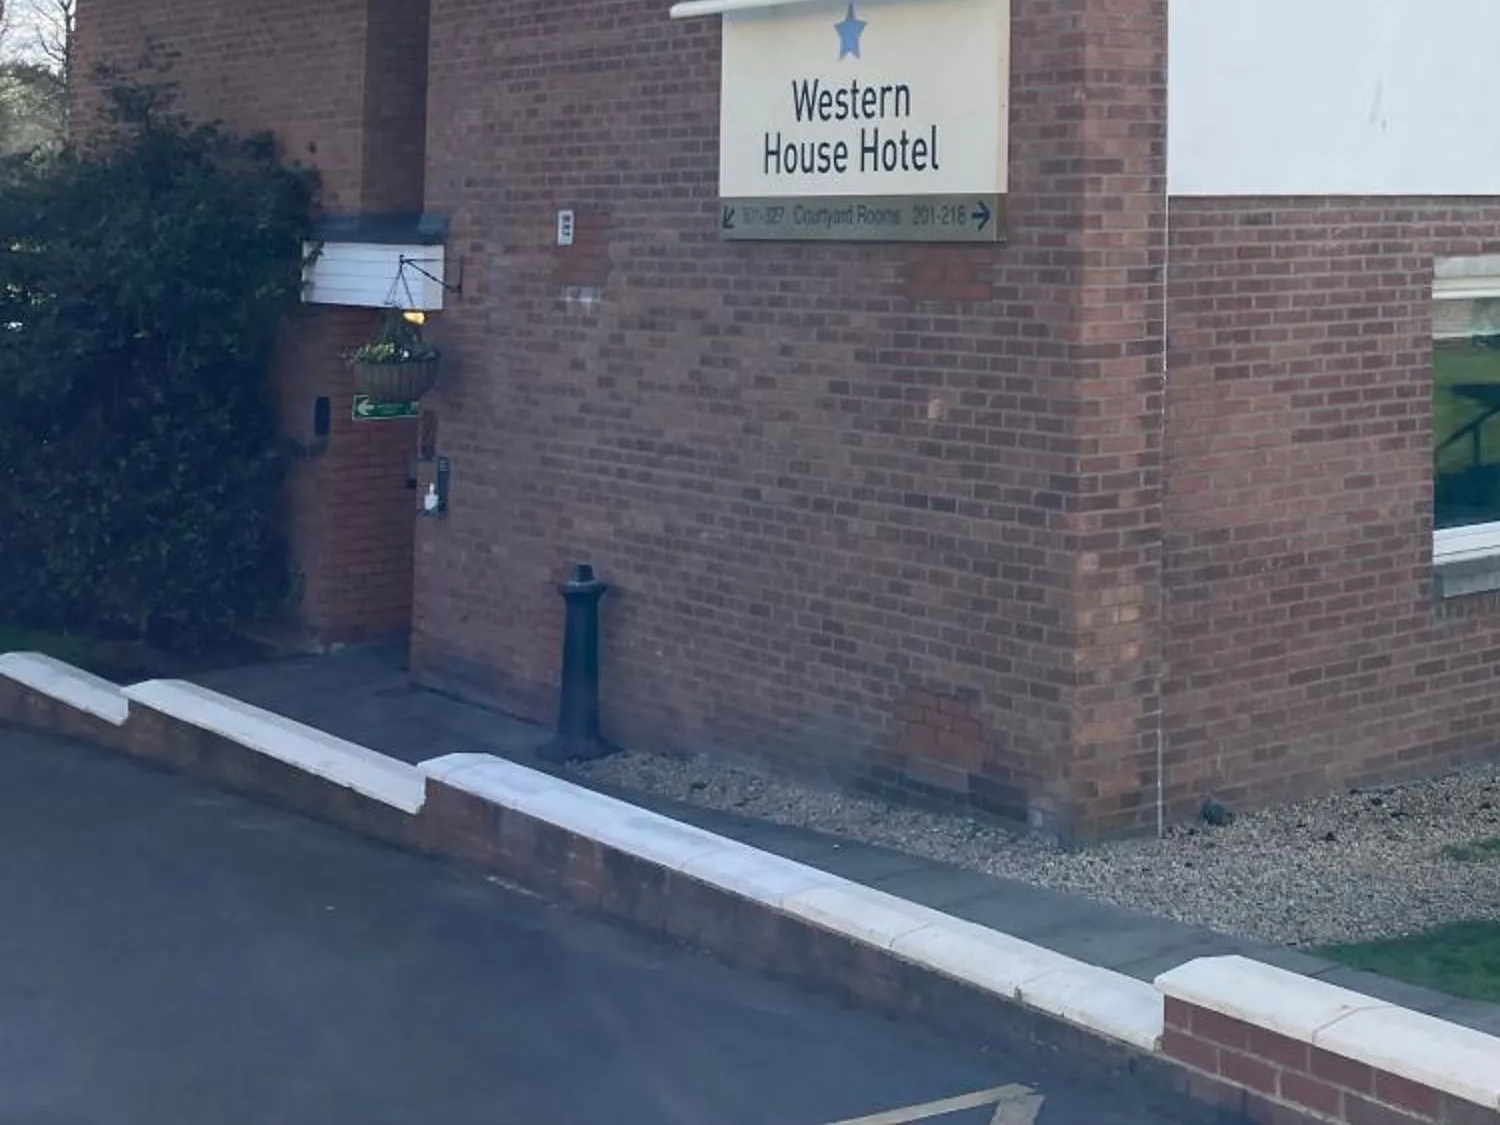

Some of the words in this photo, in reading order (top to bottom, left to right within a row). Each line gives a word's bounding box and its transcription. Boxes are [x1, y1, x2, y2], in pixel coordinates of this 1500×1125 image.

[792, 78, 910, 122] Western
[764, 131, 848, 174] House
[860, 125, 939, 172] Hotel
[793, 204, 854, 229] Courtyard
[857, 204, 901, 225] Rooms
